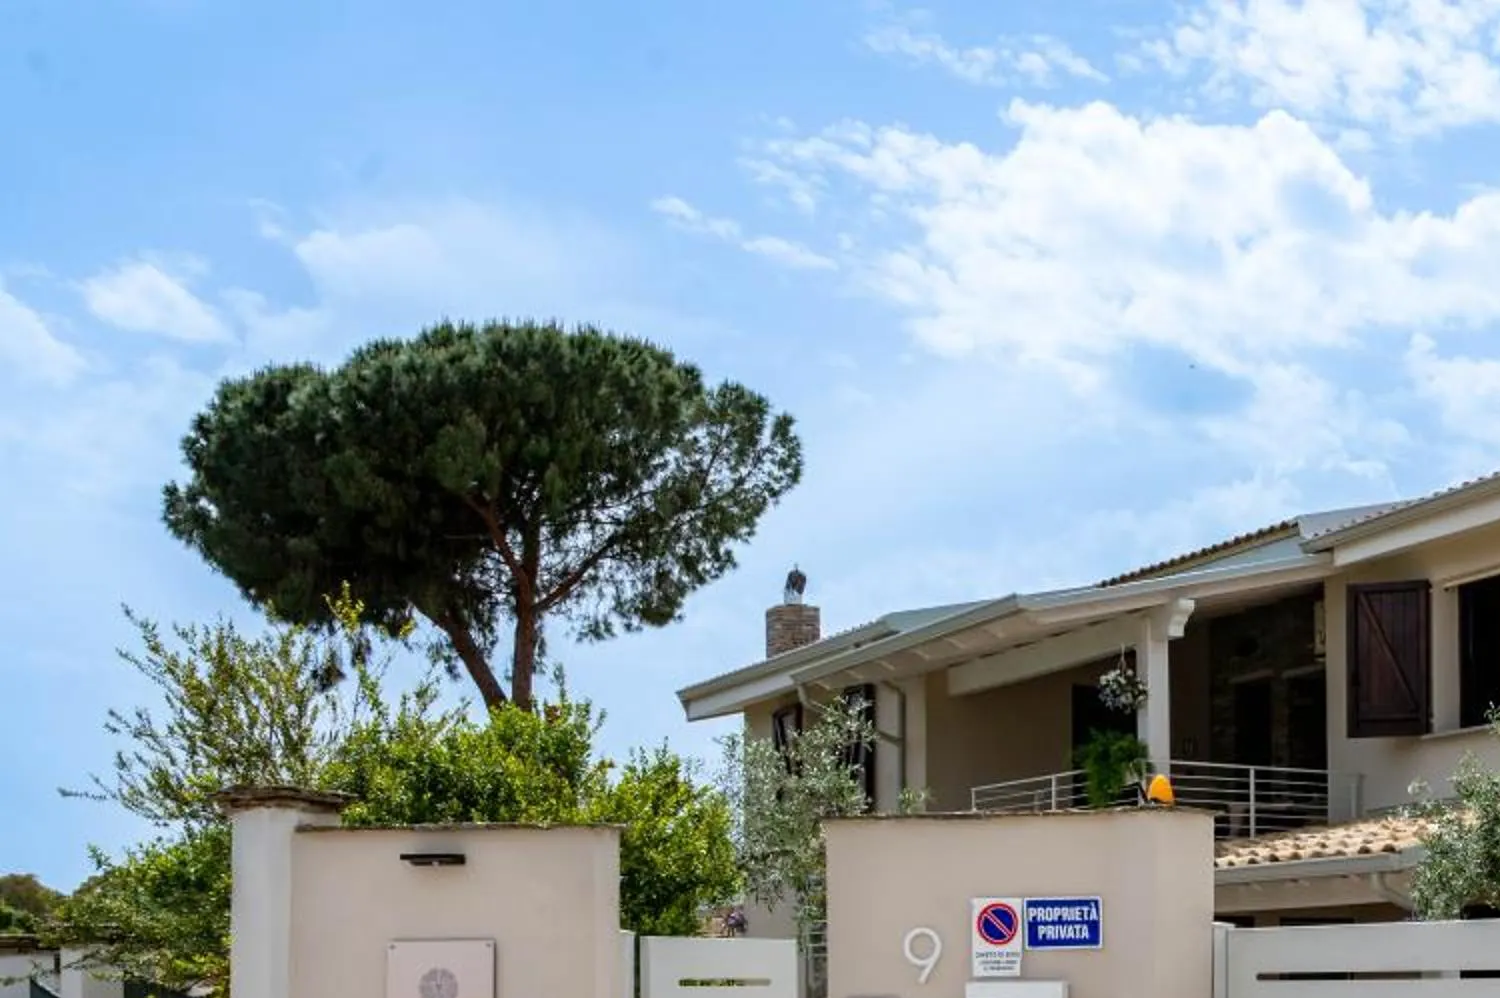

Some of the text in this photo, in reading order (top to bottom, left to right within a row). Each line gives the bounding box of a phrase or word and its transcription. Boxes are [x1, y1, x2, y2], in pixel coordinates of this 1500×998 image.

[1028, 902, 1098, 922] PROPRIETÀ
[1038, 924, 1089, 940] PRIVATA
[904, 927, 942, 984] 9
